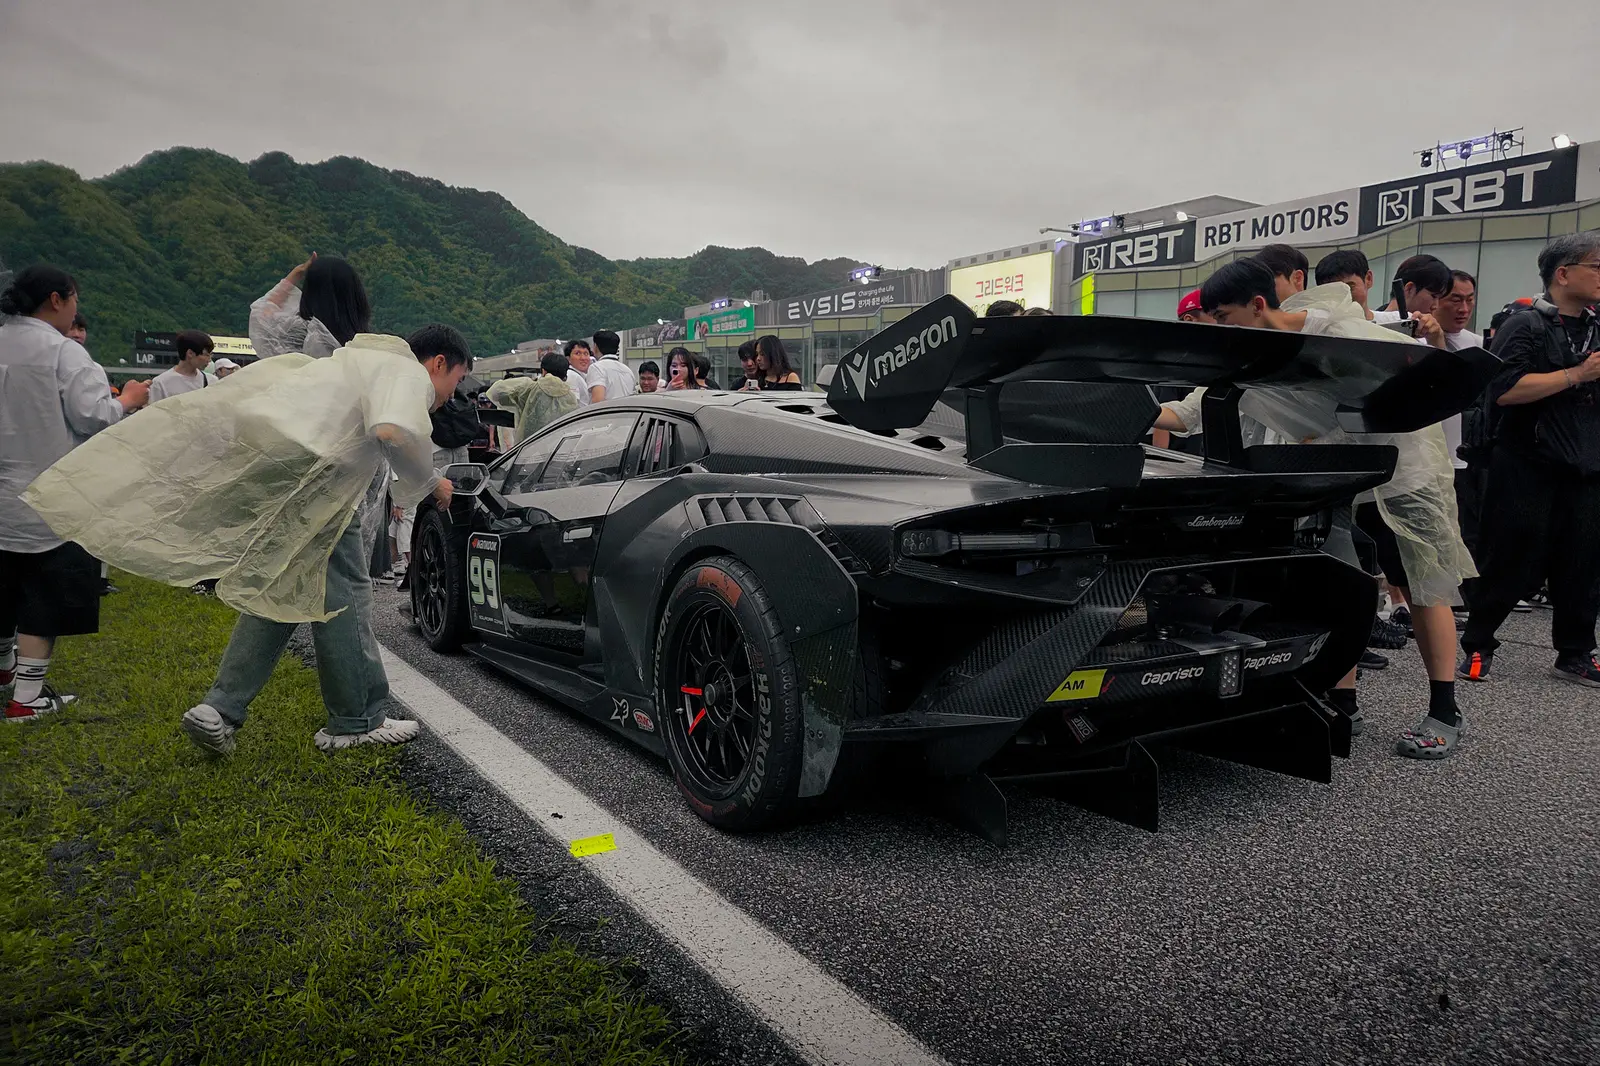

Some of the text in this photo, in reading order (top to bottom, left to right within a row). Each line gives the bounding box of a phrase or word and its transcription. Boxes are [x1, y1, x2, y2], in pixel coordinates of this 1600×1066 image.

[1423, 161, 1552, 217] RBT
[1204, 201, 1349, 248] RBT MOTORS
[1109, 229, 1184, 269] RBT
[858, 288, 878, 297] Charging
[975, 274, 1024, 298] 그리드워크
[788, 291, 857, 320] EVSIS
[136, 353, 154, 364] LAP
[873, 315, 958, 380] macron
[1188, 515, 1245, 529] Lamborghini
[470, 555, 499, 610] 99
[1060, 680, 1085, 691] AM
[1141, 666, 1205, 686] Capristo
